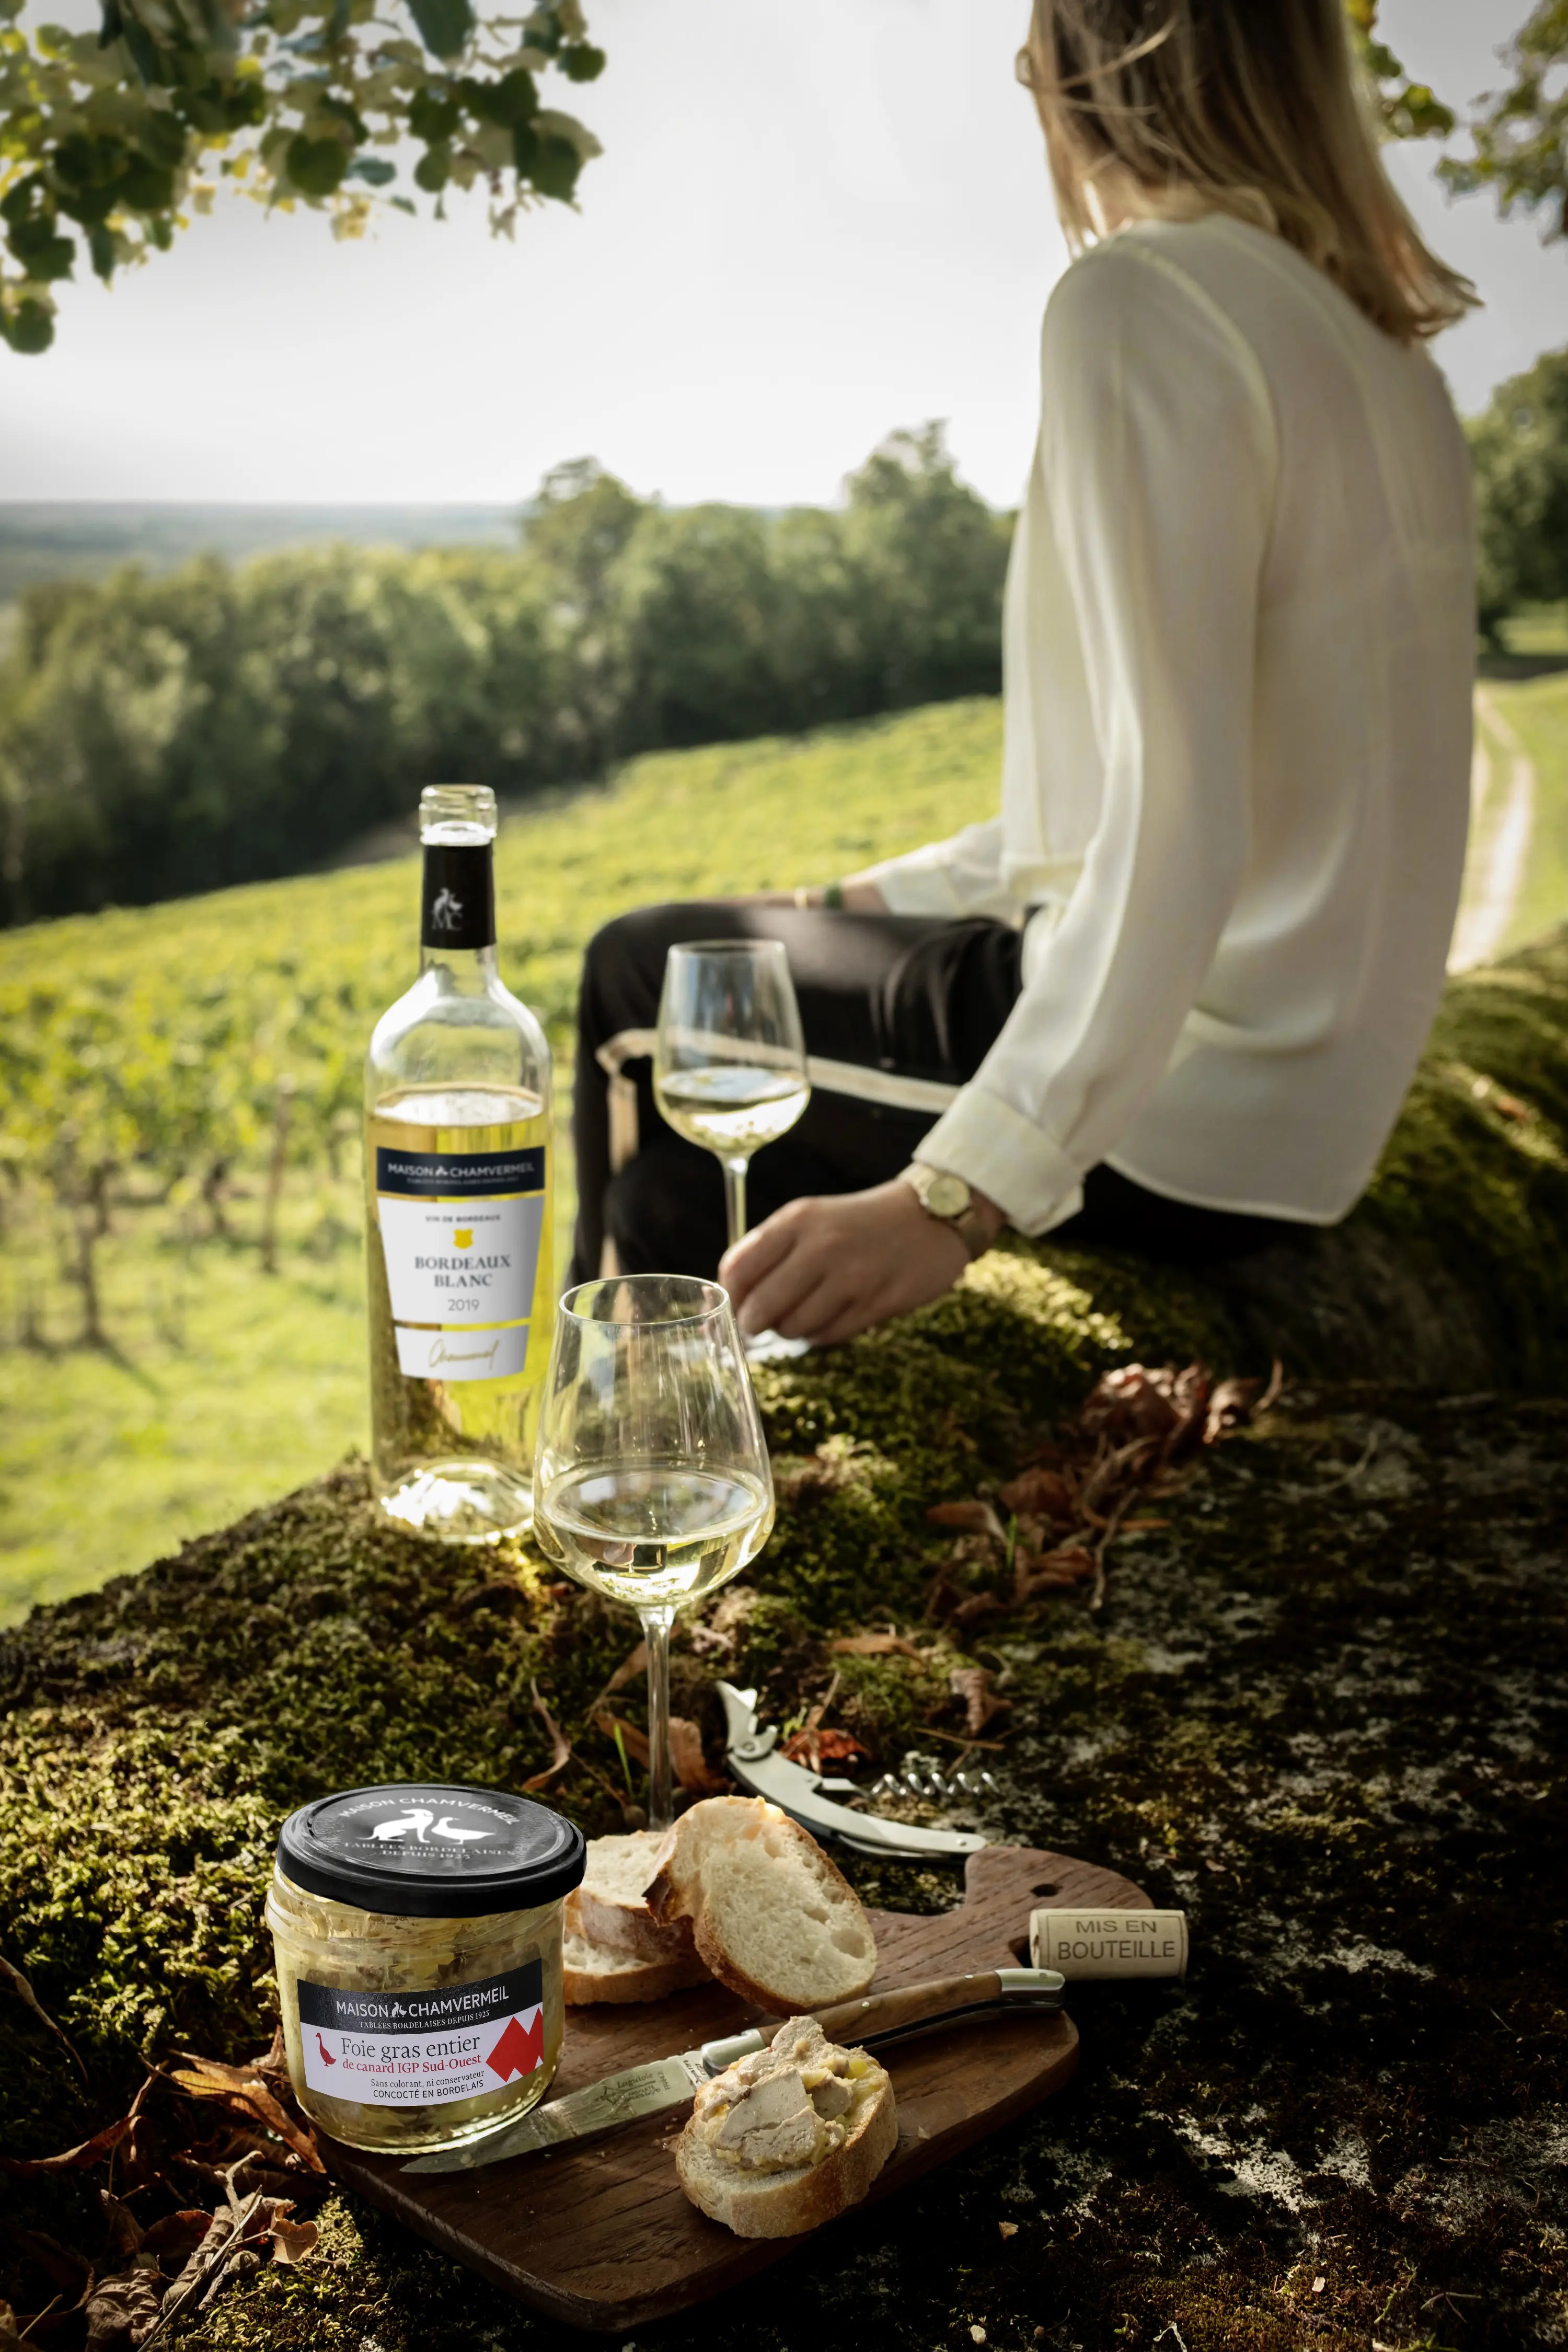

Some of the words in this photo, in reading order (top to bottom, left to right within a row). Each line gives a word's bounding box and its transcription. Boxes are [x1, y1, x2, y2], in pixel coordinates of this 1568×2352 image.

[388, 1163, 434, 1177] MAISON
[450, 1162, 535, 1178] CHAMVERMEIL
[456, 1214, 501, 1223] BORDEAUX
[415, 1255, 511, 1270] BORDEAUX
[434, 1274, 492, 1287] BLANC
[448, 1299, 479, 1311] 2019
[339, 1798, 395, 1818] MAISON
[399, 1797, 520, 1825] CHAMVERMEIL
[410, 1846, 515, 1856] BORDELAISES
[1076, 1920, 1117, 1933] MIS
[1126, 1920, 1157, 1933] EN
[1058, 1940, 1175, 1960] BOUTEILLE
[336, 2000, 389, 2018] MAISON
[408, 1986, 509, 2017] CHAMVERMEIL
[359, 2021, 391, 2029] TABLÉES
[393, 2019, 445, 2029] BORDELAISES
[447, 2013, 474, 2025] DEPUIS
[475, 2010, 490, 2020] 1923
[341, 2037, 376, 2058] Foie
[381, 2045, 420, 2063] gras
[426, 2036, 480, 2057] entier
[342, 2058, 354, 2070] de
[356, 2062, 395, 2074] canard
[397, 2062, 419, 2073] IGP
[422, 2055, 482, 2073] Sud-Ouest
[371, 2079, 388, 2087] Sans
[390, 2080, 424, 2088] colorant,
[426, 2079, 434, 2087] ni
[436, 2070, 484, 2086] conservateur
[373, 2089, 419, 2099] CONCOCTÉ
[437, 2080, 483, 2096] BORDELAIS
